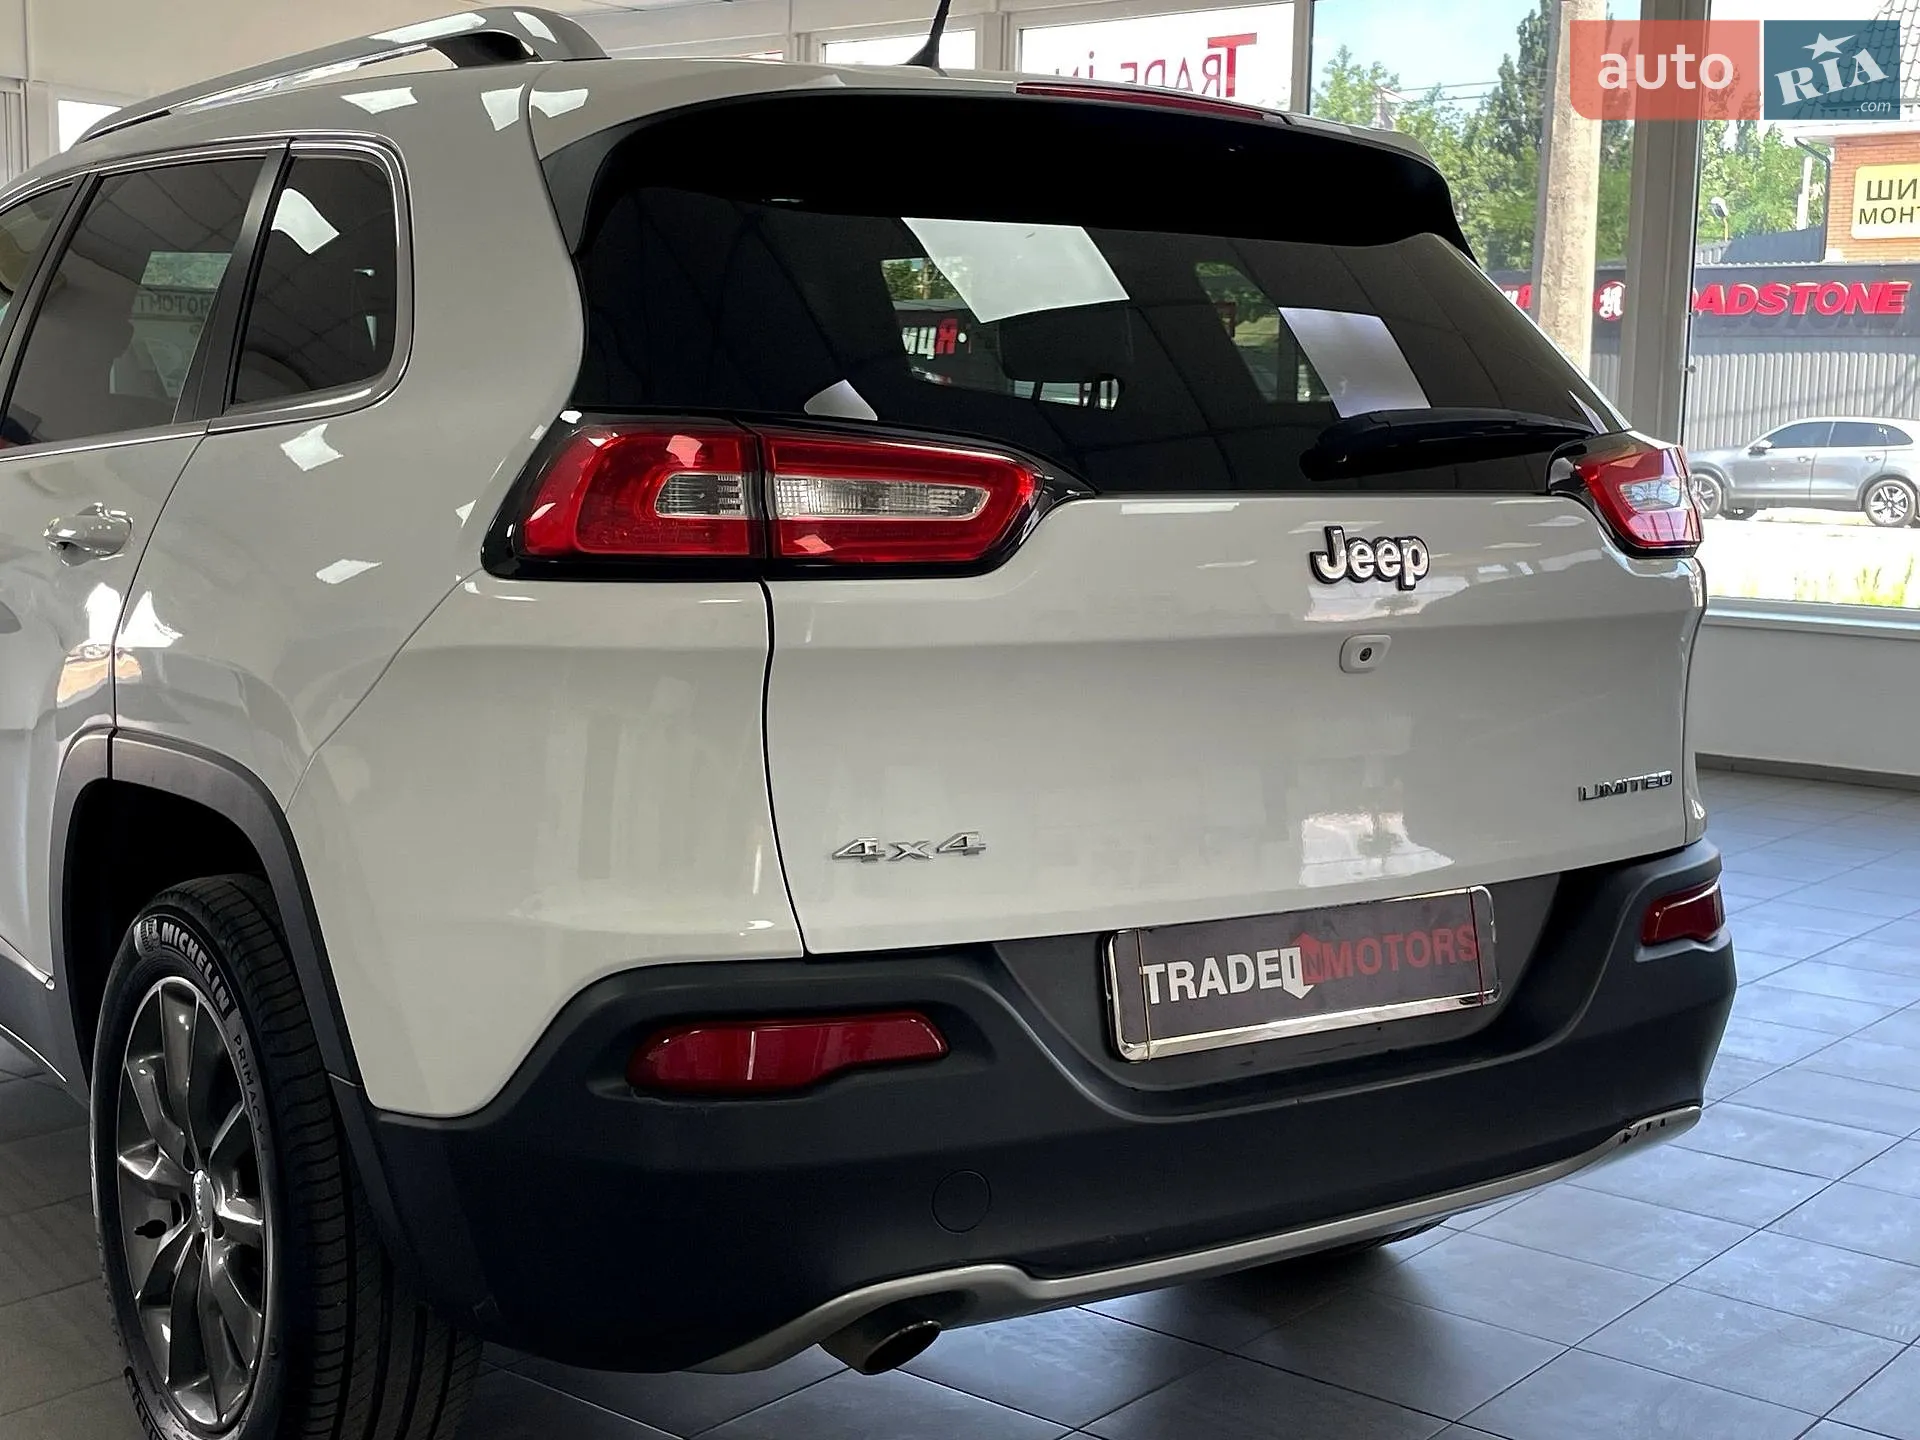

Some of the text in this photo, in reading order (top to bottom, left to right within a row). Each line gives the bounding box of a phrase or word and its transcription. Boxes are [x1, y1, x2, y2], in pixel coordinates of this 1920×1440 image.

[1866, 178, 1917, 201] ШИ
[1310, 526, 1430, 591] Jeep
[1578, 770, 1672, 802] LIMITED
[161, 921, 231, 1013] MICHELIN
[1139, 949, 1281, 1004] TRADE
[1322, 924, 1478, 985] MOTORS
[233, 1034, 266, 1136] PRIMACY
